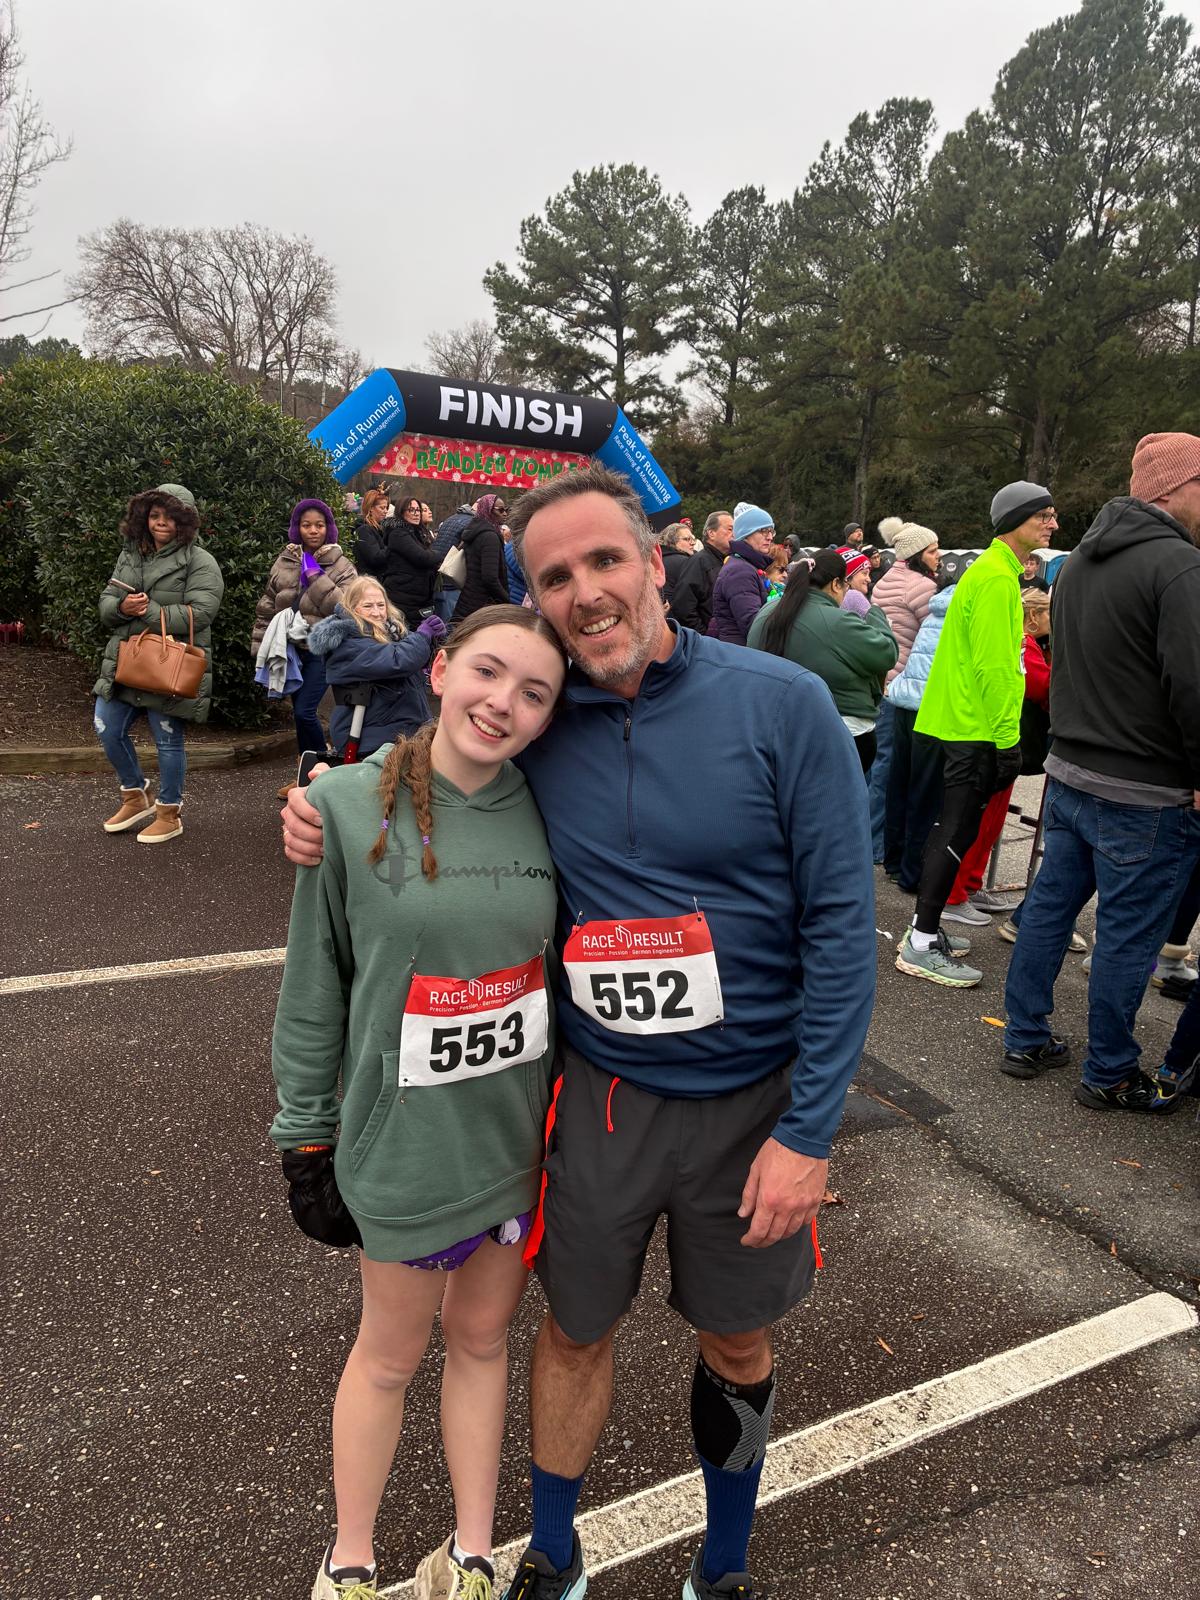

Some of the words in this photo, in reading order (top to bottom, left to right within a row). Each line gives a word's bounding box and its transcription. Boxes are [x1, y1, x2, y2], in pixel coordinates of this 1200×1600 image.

[344, 443, 365, 461] Timing
[362, 438, 369, 446] &
[367, 406, 401, 441] Management
[346, 429, 359, 445] of
[355, 394, 398, 435] Running
[439, 385, 583, 438] FINISH
[416, 447, 507, 476] REINDEER
[613, 434, 625, 450] Race
[623, 448, 637, 468] Timing
[639, 471, 664, 506] Management
[618, 425, 637, 451] Peak
[635, 451, 646, 462] of
[643, 461, 672, 503] Running
[372, 853, 552, 897] Campion
[582, 935, 616, 949] RACE
[633, 931, 684, 947] RESULT
[652, 947, 684, 955] Engineering
[430, 989, 468, 1005] RACE
[485, 973, 529, 998] RESULT
[459, 1003, 479, 1011] Passion
[482, 999, 503, 1007] German
[590, 970, 694, 1021] 552
[429, 1011, 525, 1073] 553
